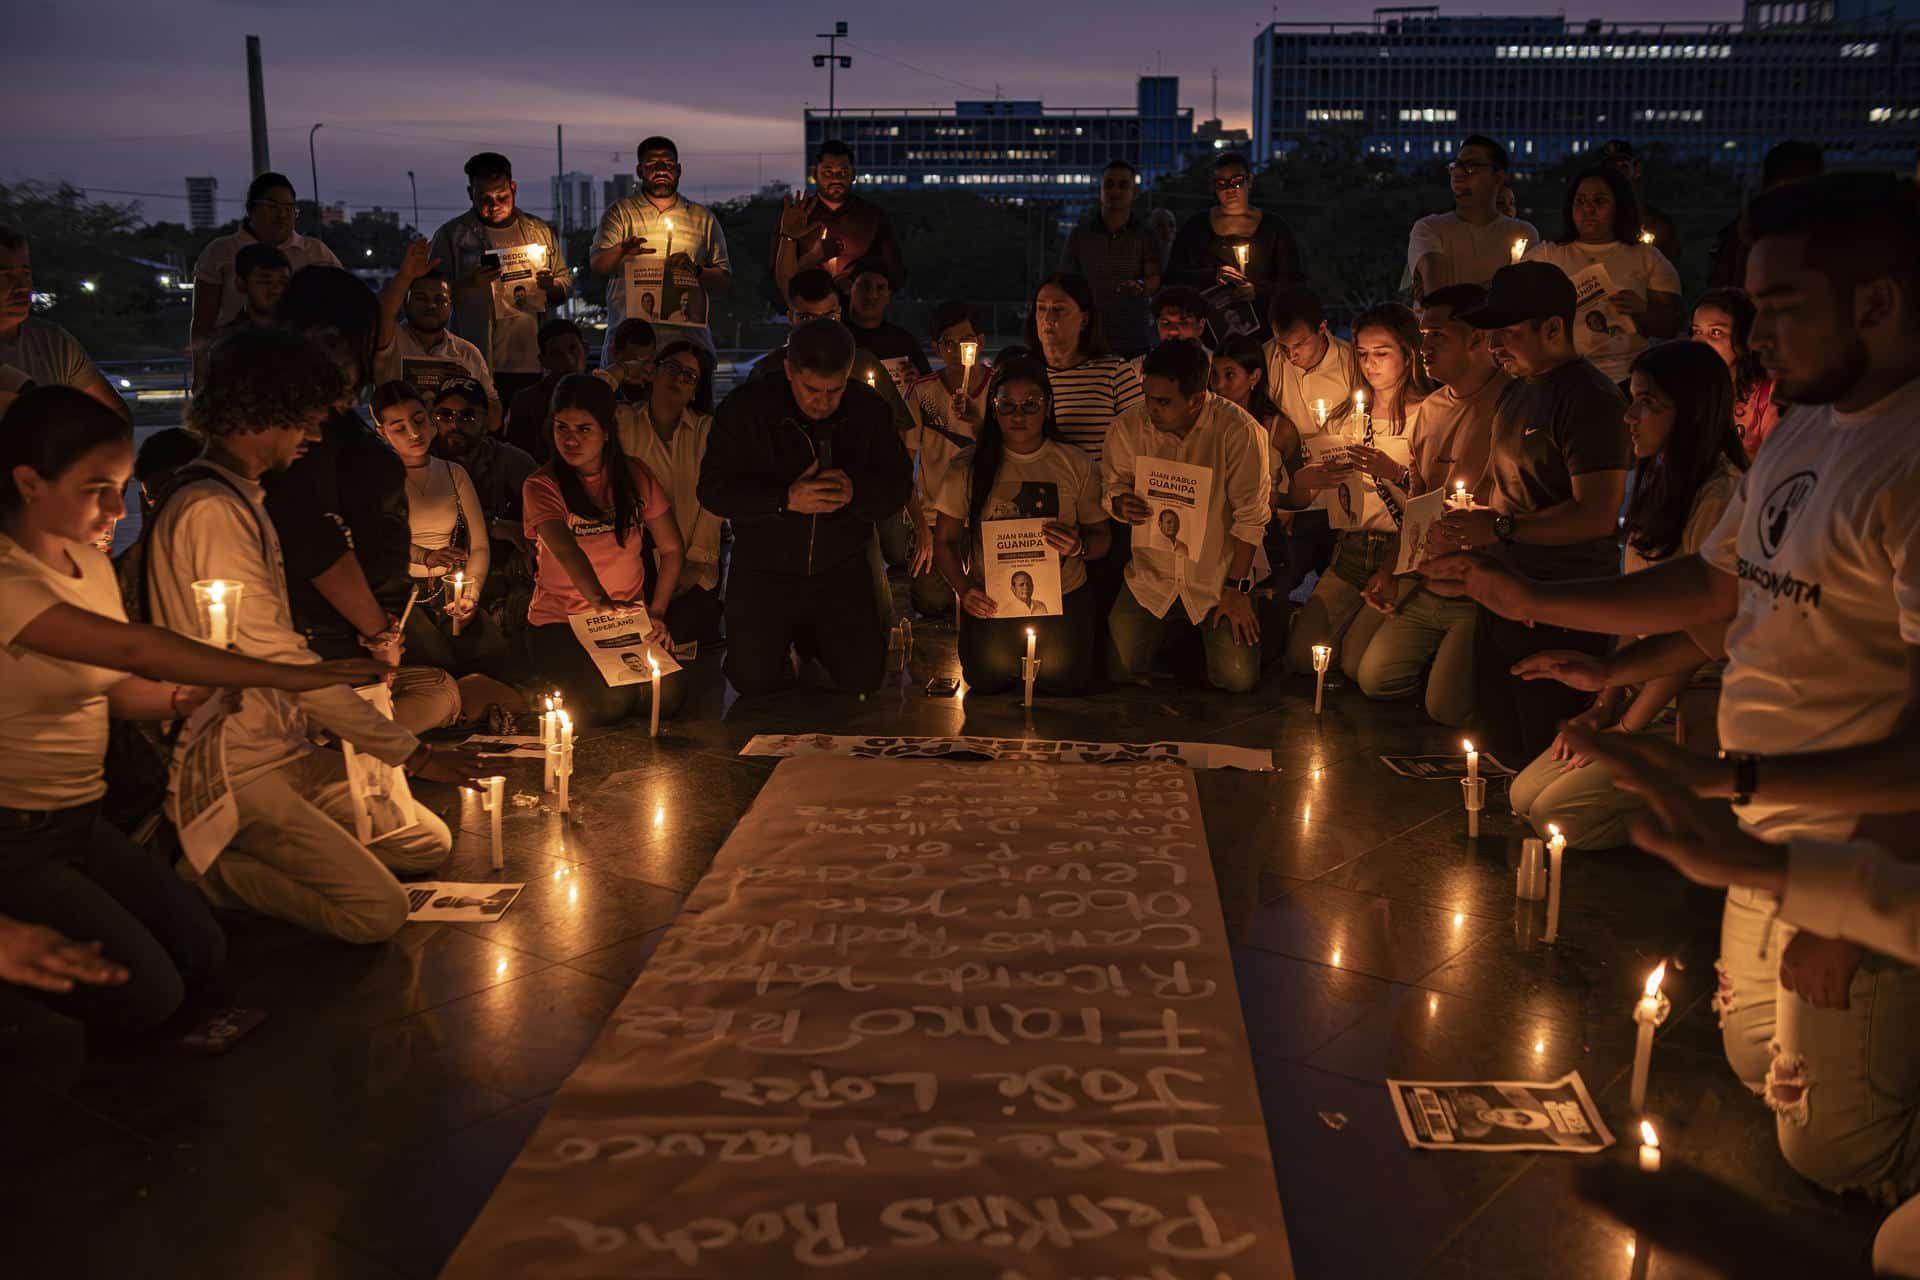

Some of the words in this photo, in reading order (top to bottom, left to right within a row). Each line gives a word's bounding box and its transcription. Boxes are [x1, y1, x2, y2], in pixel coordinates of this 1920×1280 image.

[1148, 478, 1196, 494] GUANIPA
[1151, 471, 1169, 480] JUAN
[1171, 475, 1197, 485] PABLO
[997, 539, 1044, 550] GUANIPA
[998, 532, 1016, 541] JUAN
[910, 960, 1217, 1000] Ricardo
[850, 1004, 1207, 1055] Franco
[554, 1130, 867, 1168] Mazuco
[548, 1202, 867, 1267] Rocha
